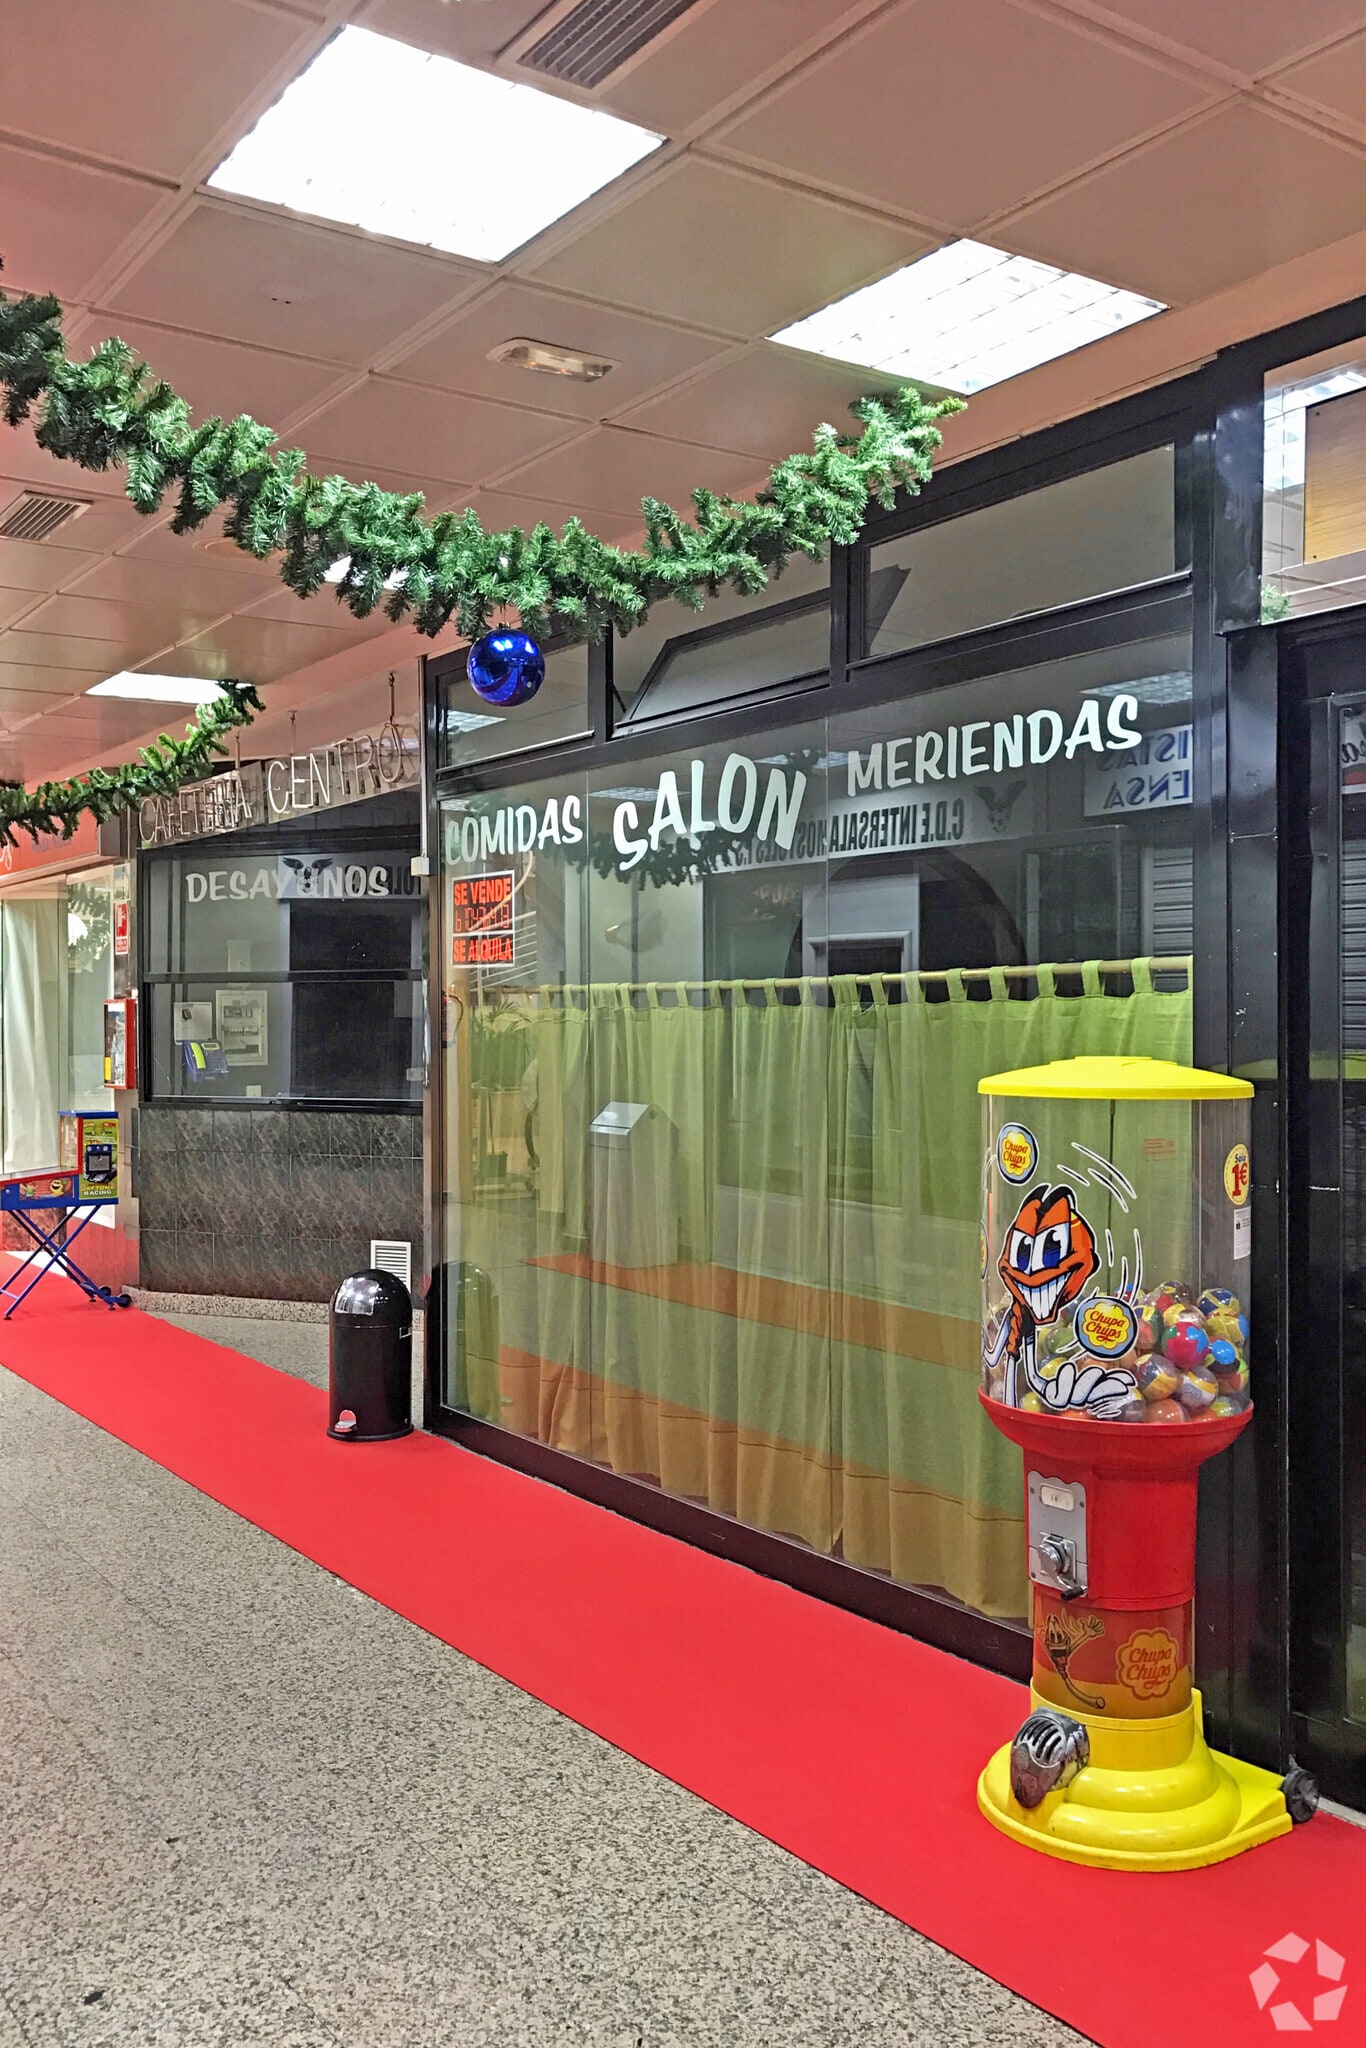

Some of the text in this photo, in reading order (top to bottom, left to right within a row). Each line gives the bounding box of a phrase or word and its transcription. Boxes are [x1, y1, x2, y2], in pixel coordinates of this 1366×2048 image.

[267, 722, 404, 814] CENTRO
[445, 694, 1142, 871] COMIDAS SALON MERIENDAS
[185, 864, 390, 903] DESAYUNOS
[454, 877, 512, 905] SE VENDE
[453, 938, 512, 962] SE ALQUILA
[1003, 1150, 1026, 1167] Chups
[1004, 1140, 1028, 1155] Chupa
[1232, 1162, 1248, 1197] 1€
[1086, 1321, 1122, 1341] Chups
[1090, 1310, 1125, 1328] Chupa
[1128, 1647, 1173, 1666] Chupa
[1126, 1663, 1171, 1688] Chups
